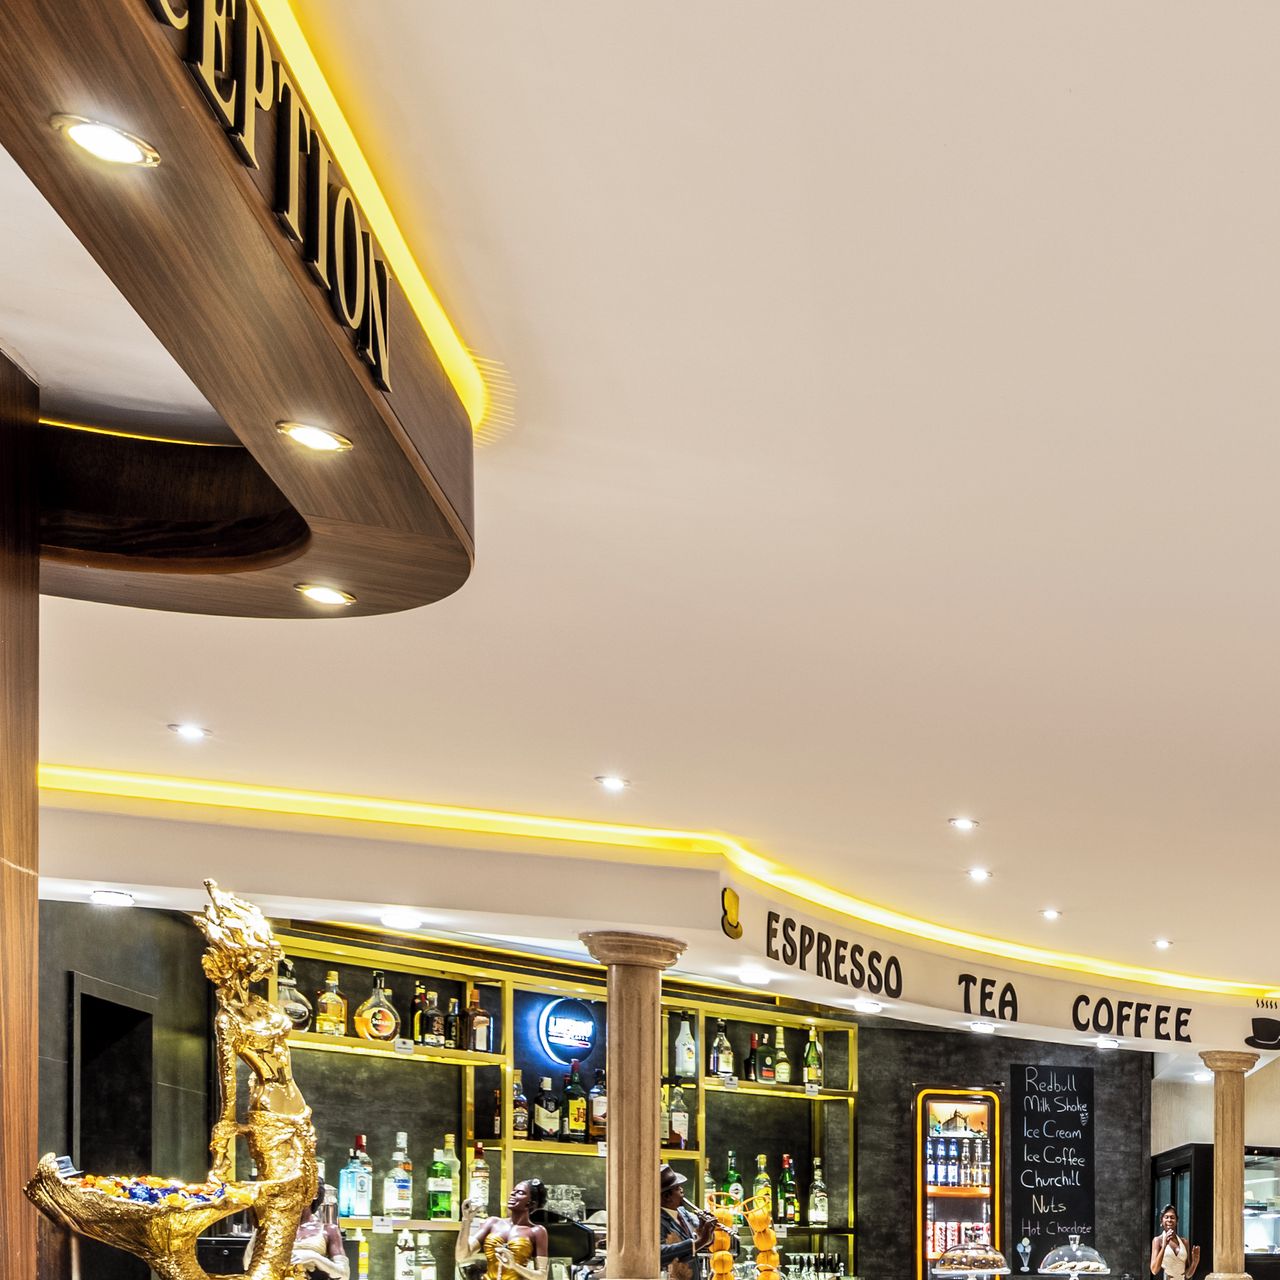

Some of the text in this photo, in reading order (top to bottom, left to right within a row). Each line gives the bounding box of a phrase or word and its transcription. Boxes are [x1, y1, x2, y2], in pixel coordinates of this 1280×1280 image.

[155, 0, 392, 393] EPTION
[767, 911, 1192, 1043] ESPRESSO TEA COFFEE
[1025, 1066, 1077, 1092] Redbull
[1023, 1095, 1051, 1112] Milk
[1023, 1116, 1082, 1139] Ice Cream
[1023, 1144, 1086, 1167] Ice Coffee
[1020, 1169, 1081, 1188] Churchill
[1032, 1194, 1067, 1214] Nuts
[1021, 1218, 1041, 1236] Hot
